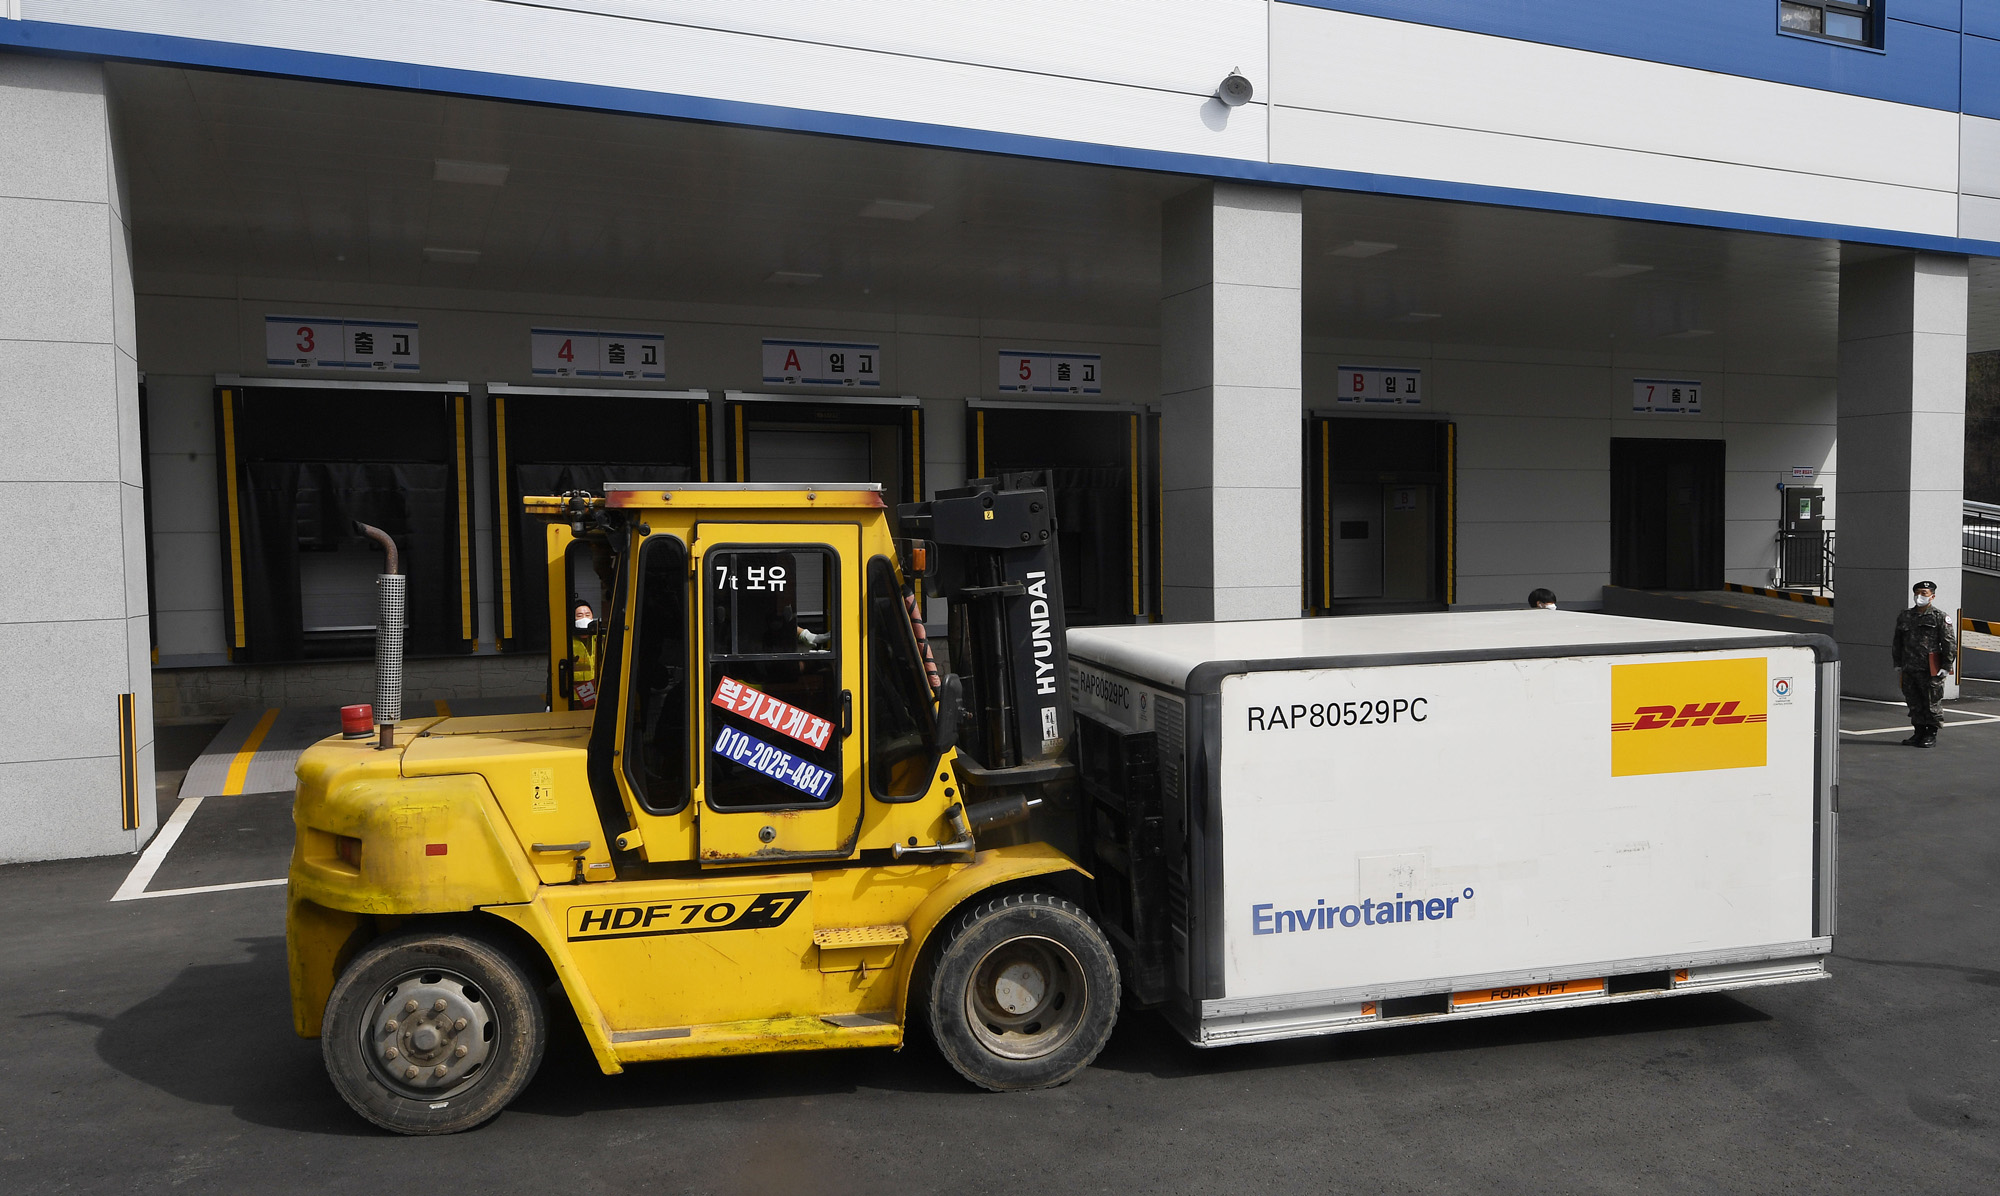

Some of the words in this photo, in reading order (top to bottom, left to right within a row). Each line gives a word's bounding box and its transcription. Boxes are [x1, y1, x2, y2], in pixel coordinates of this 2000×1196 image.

[296, 326, 315, 352] 3
[558, 338, 574, 362] 4
[783, 348, 802, 371] A
[1019, 359, 1032, 380] 5
[1353, 373, 1365, 391] B
[1646, 385, 1655, 402] 7
[715, 565, 739, 590] 7t
[746, 565, 787, 592] 보유
[1026, 570, 1057, 696] HYUNDAI
[1080, 671, 1130, 709] RAP80529PC
[717, 678, 831, 748] 럭키지게차
[1247, 697, 1429, 732] RAP80529PC
[1632, 700, 1748, 731] DHL
[715, 727, 833, 797] 010-2025-4847
[578, 904, 673, 932] HDF
[679, 902, 737, 925] 70
[1490, 986, 1533, 1000] FORK
[1537, 982, 1569, 995] LIFT
